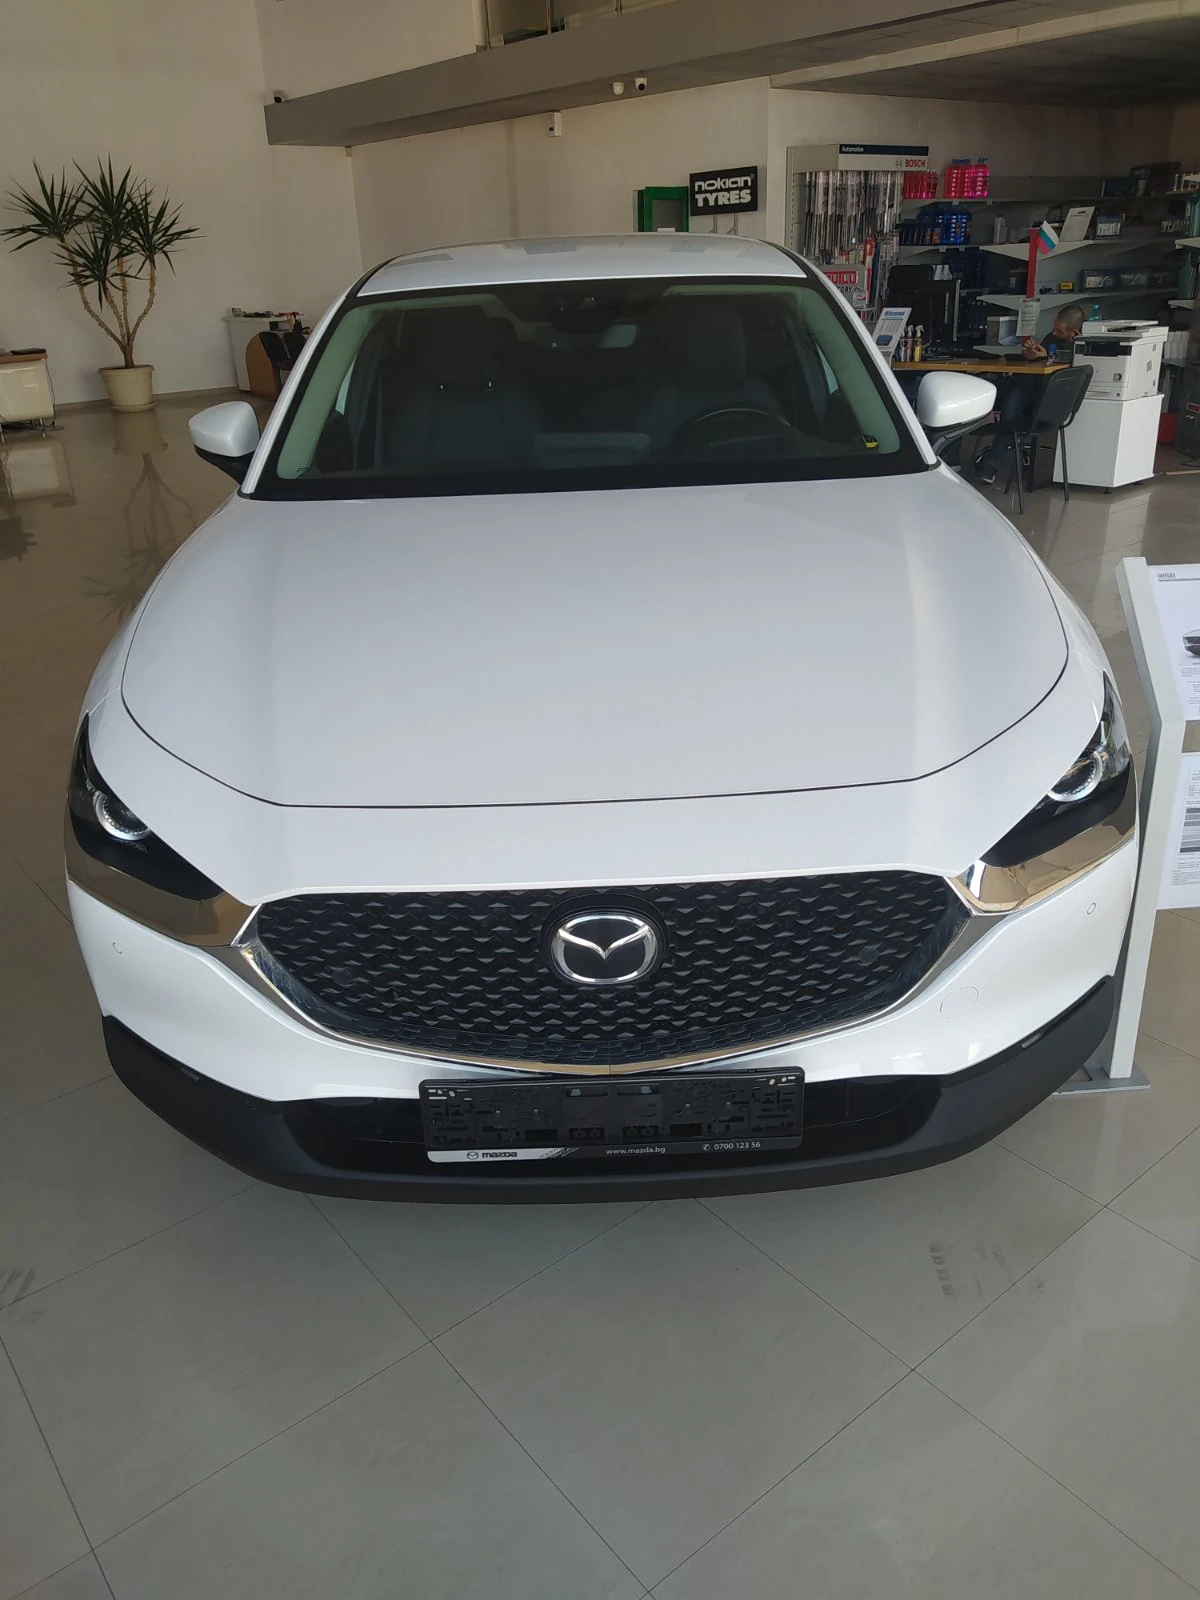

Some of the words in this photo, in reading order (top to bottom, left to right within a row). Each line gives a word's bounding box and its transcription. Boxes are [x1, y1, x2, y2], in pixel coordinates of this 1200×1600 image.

[904, 159, 926, 168] BOSCH
[694, 176, 752, 192] nokian
[694, 189, 752, 207] TYRES
[481, 1151, 518, 1159] mazda
[605, 1146, 666, 1155] www.mazda.bg
[713, 1142, 734, 1150] 0700
